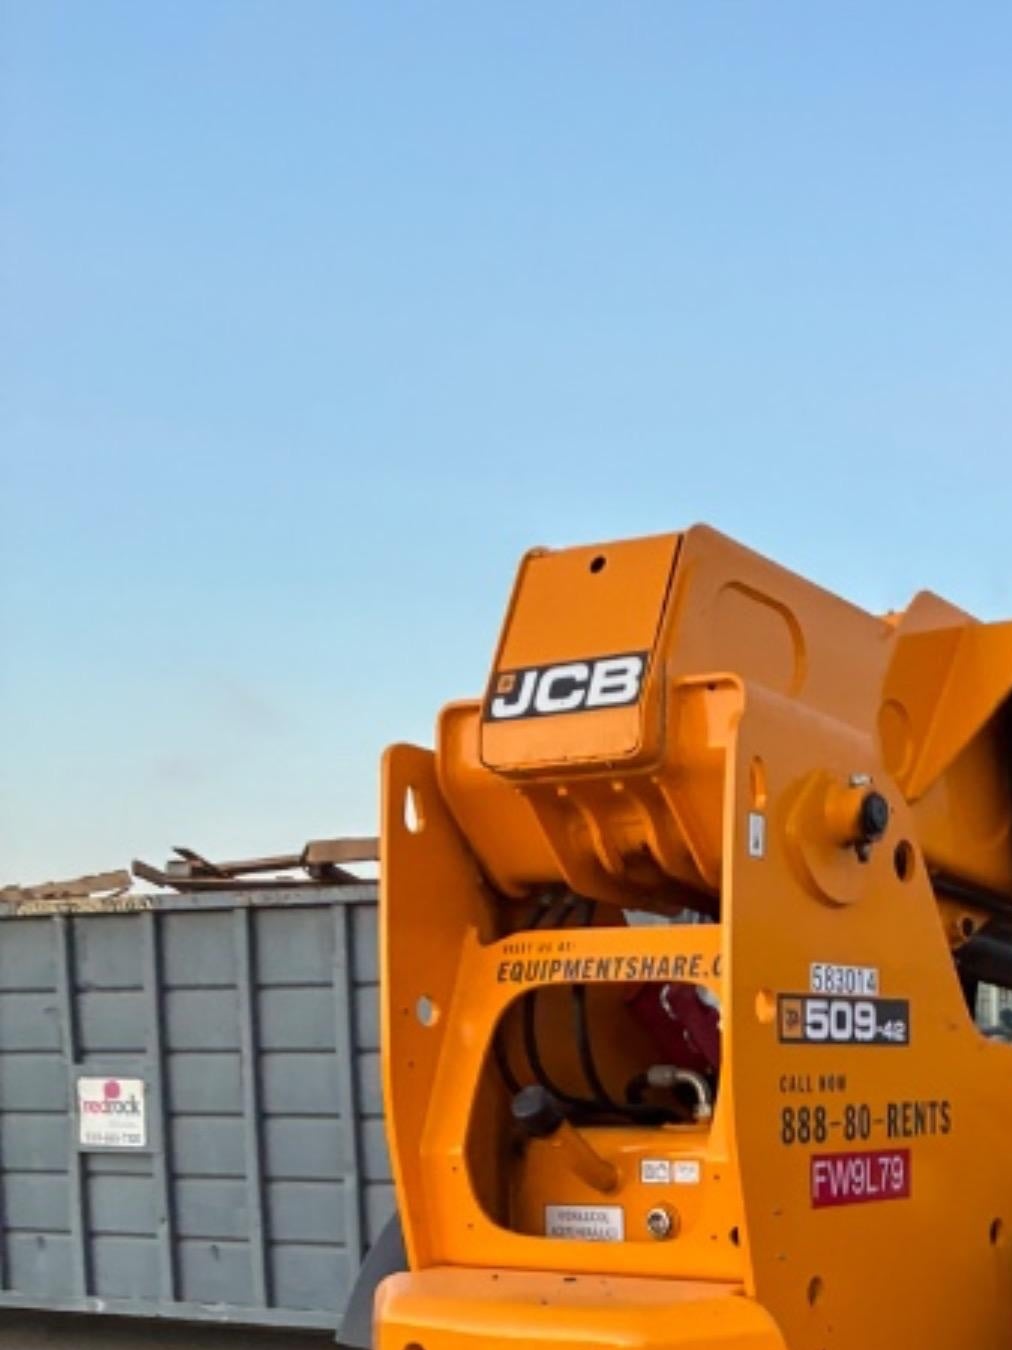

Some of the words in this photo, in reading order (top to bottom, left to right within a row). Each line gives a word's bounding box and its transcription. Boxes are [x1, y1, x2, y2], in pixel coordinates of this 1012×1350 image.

[490, 655, 643, 719] JCB
[812, 965, 876, 993] 583014
[779, 1073, 813, 1093] CALL
[781, 1101, 951, 1145] 888-80-RENTS
[812, 1155, 904, 1198] FW9L79
